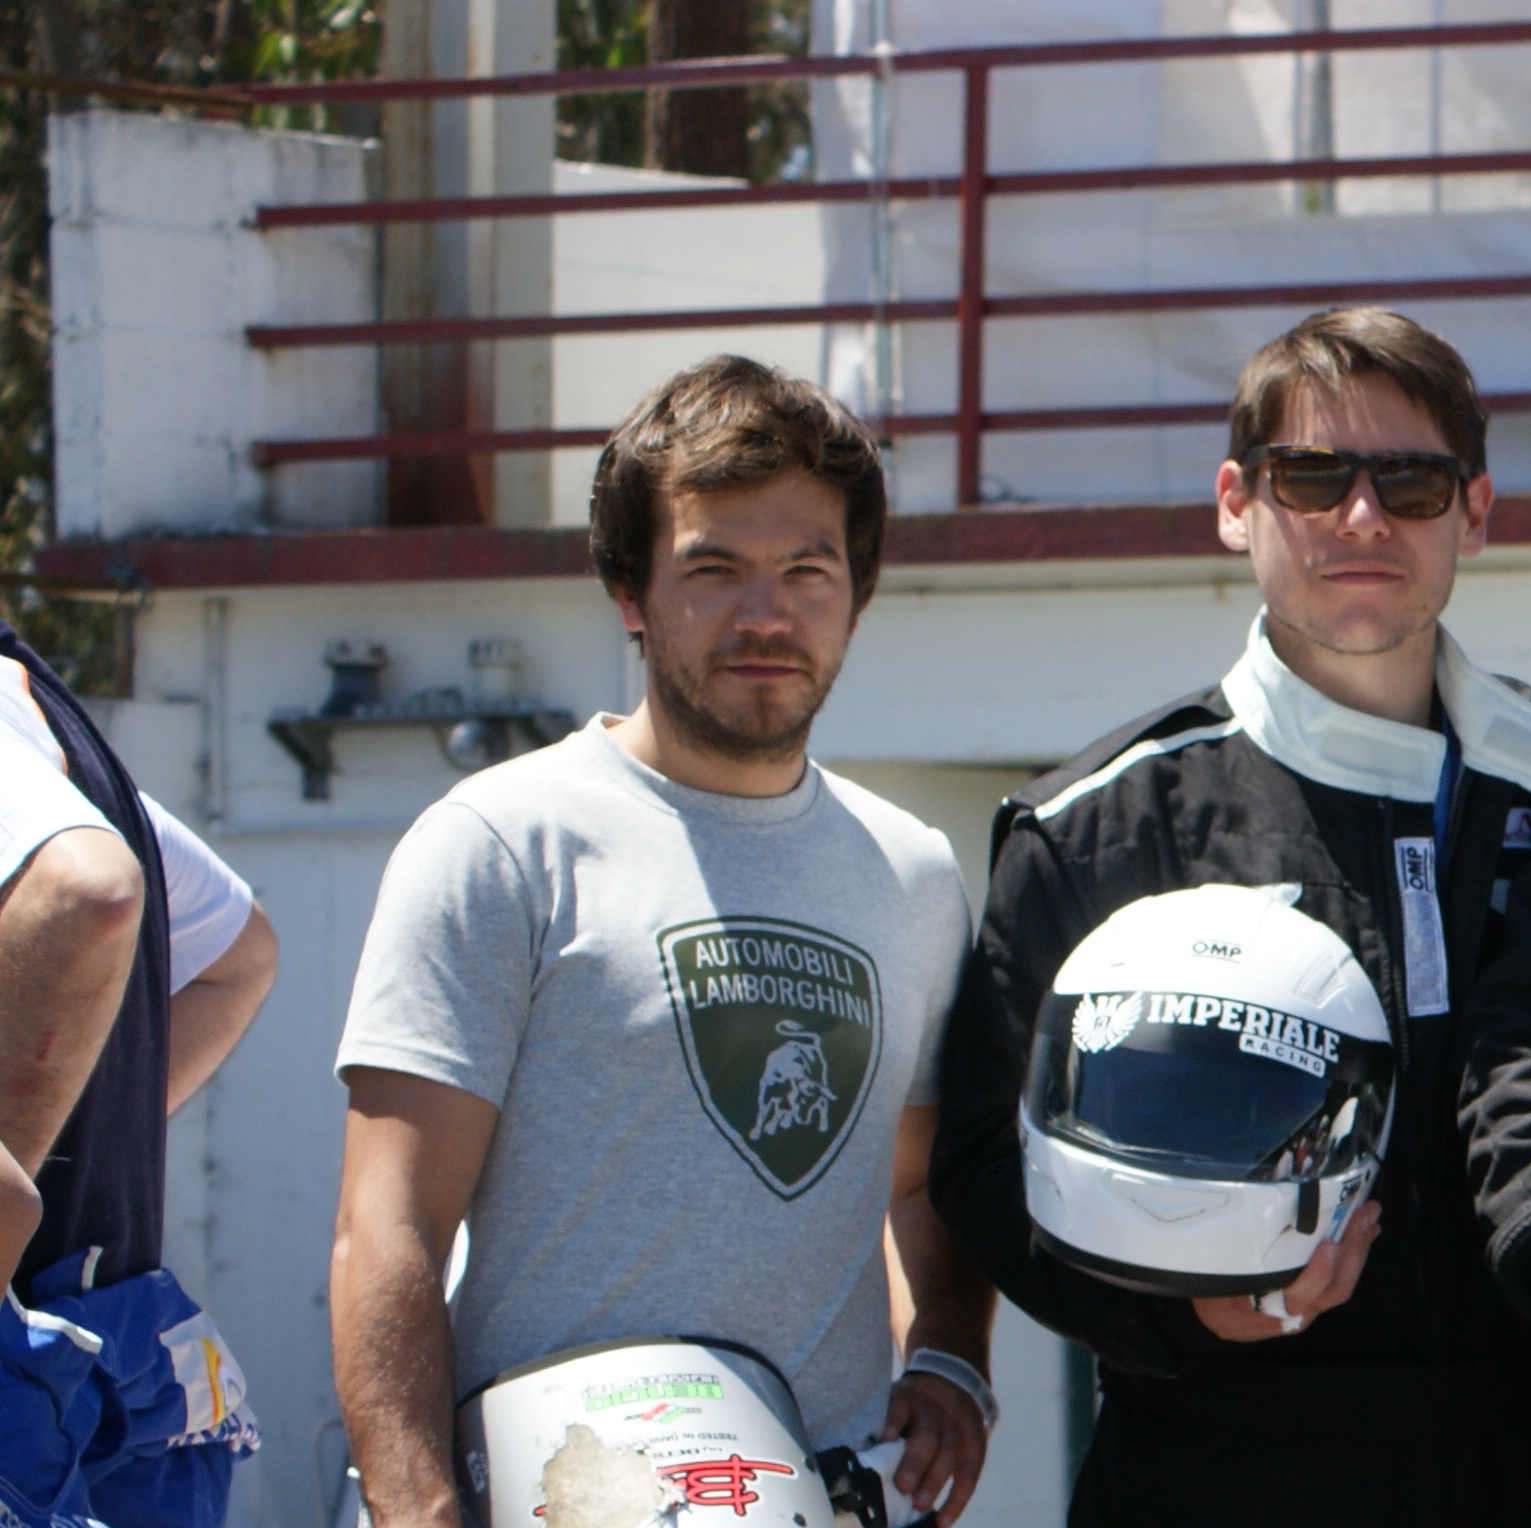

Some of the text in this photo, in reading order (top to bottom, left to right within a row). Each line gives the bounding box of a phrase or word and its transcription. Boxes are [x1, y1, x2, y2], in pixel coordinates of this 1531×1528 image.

[1407, 846, 1424, 891] OMP
[695, 937, 855, 986] AUTOMOBILI
[1191, 941, 1242, 958] OMP
[689, 974, 872, 1029] LAMBORGHINI
[1146, 994, 1341, 1064] IMPERIALE
[1244, 1038, 1323, 1073] RACING
